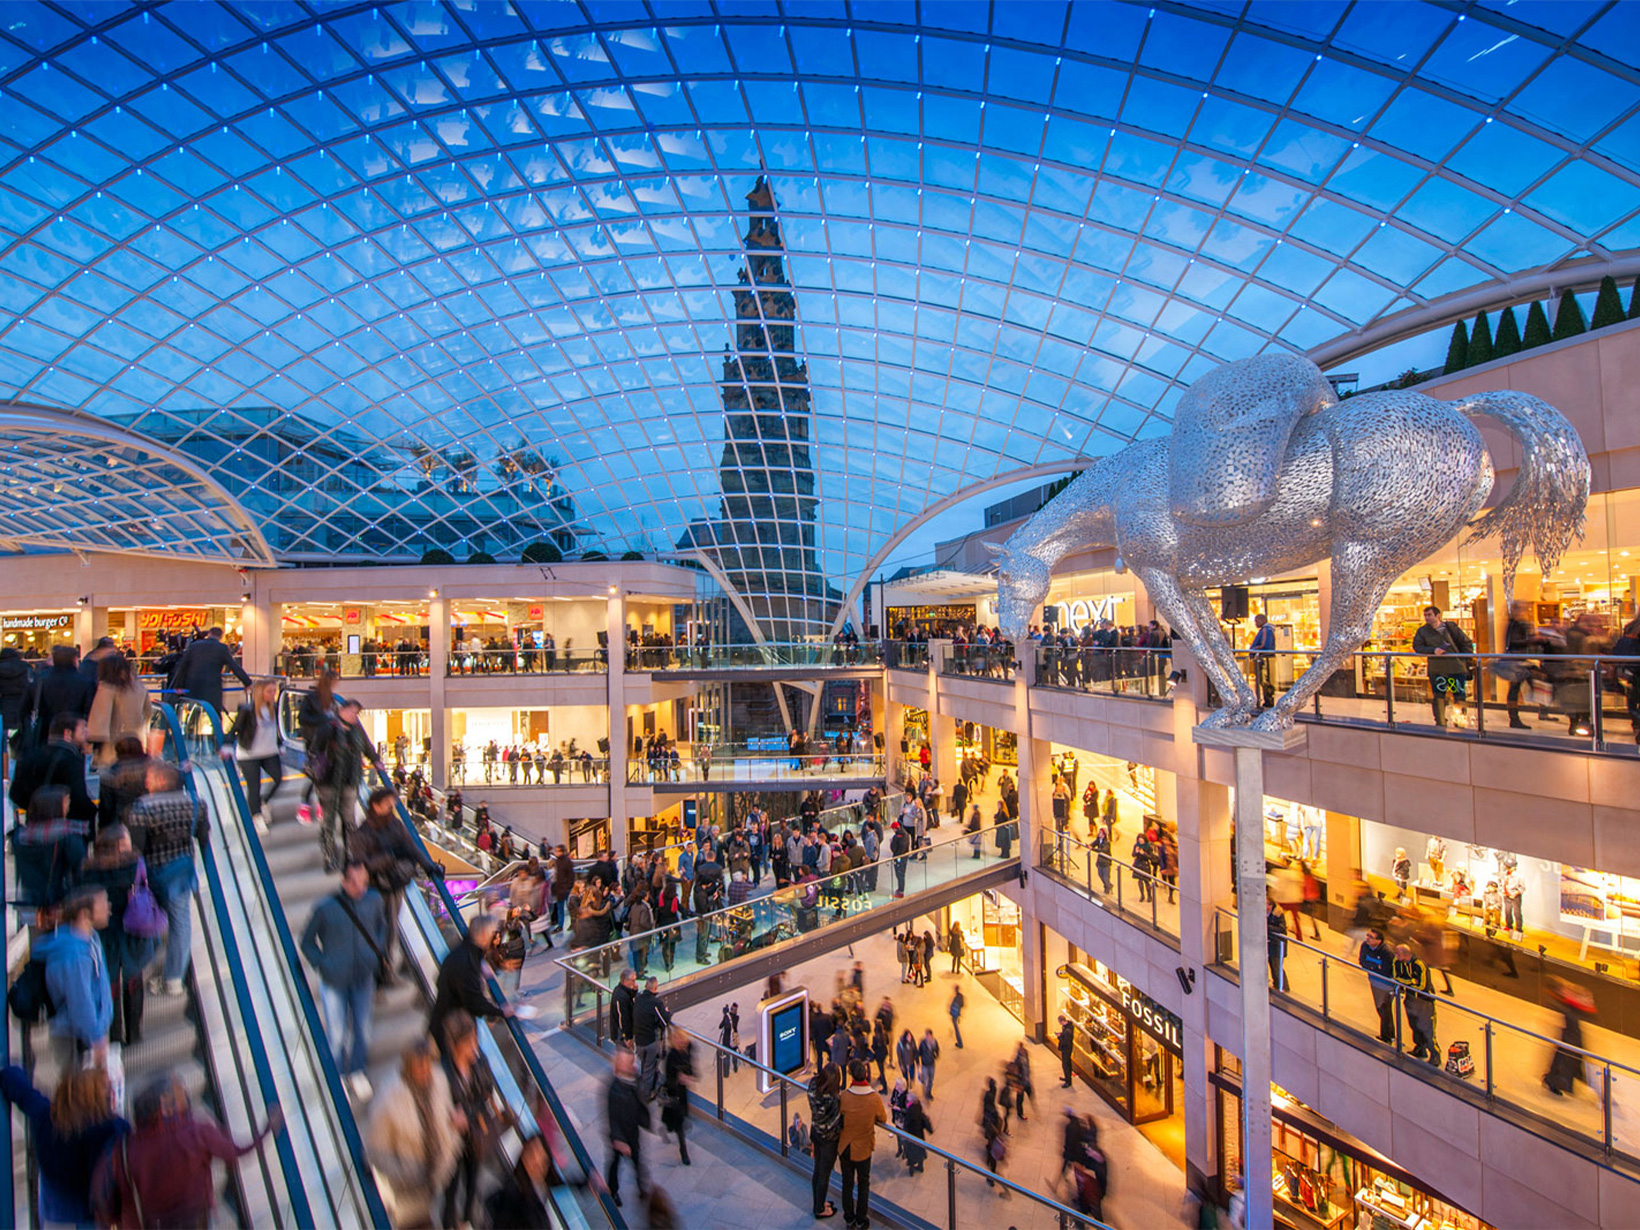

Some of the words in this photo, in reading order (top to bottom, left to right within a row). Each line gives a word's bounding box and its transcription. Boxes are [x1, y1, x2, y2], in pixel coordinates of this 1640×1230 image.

[3, 617, 34, 628] handmade
[34, 616, 58, 630] burger
[1053, 595, 1124, 636] next
[1122, 991, 1181, 1049] FOSSIL
